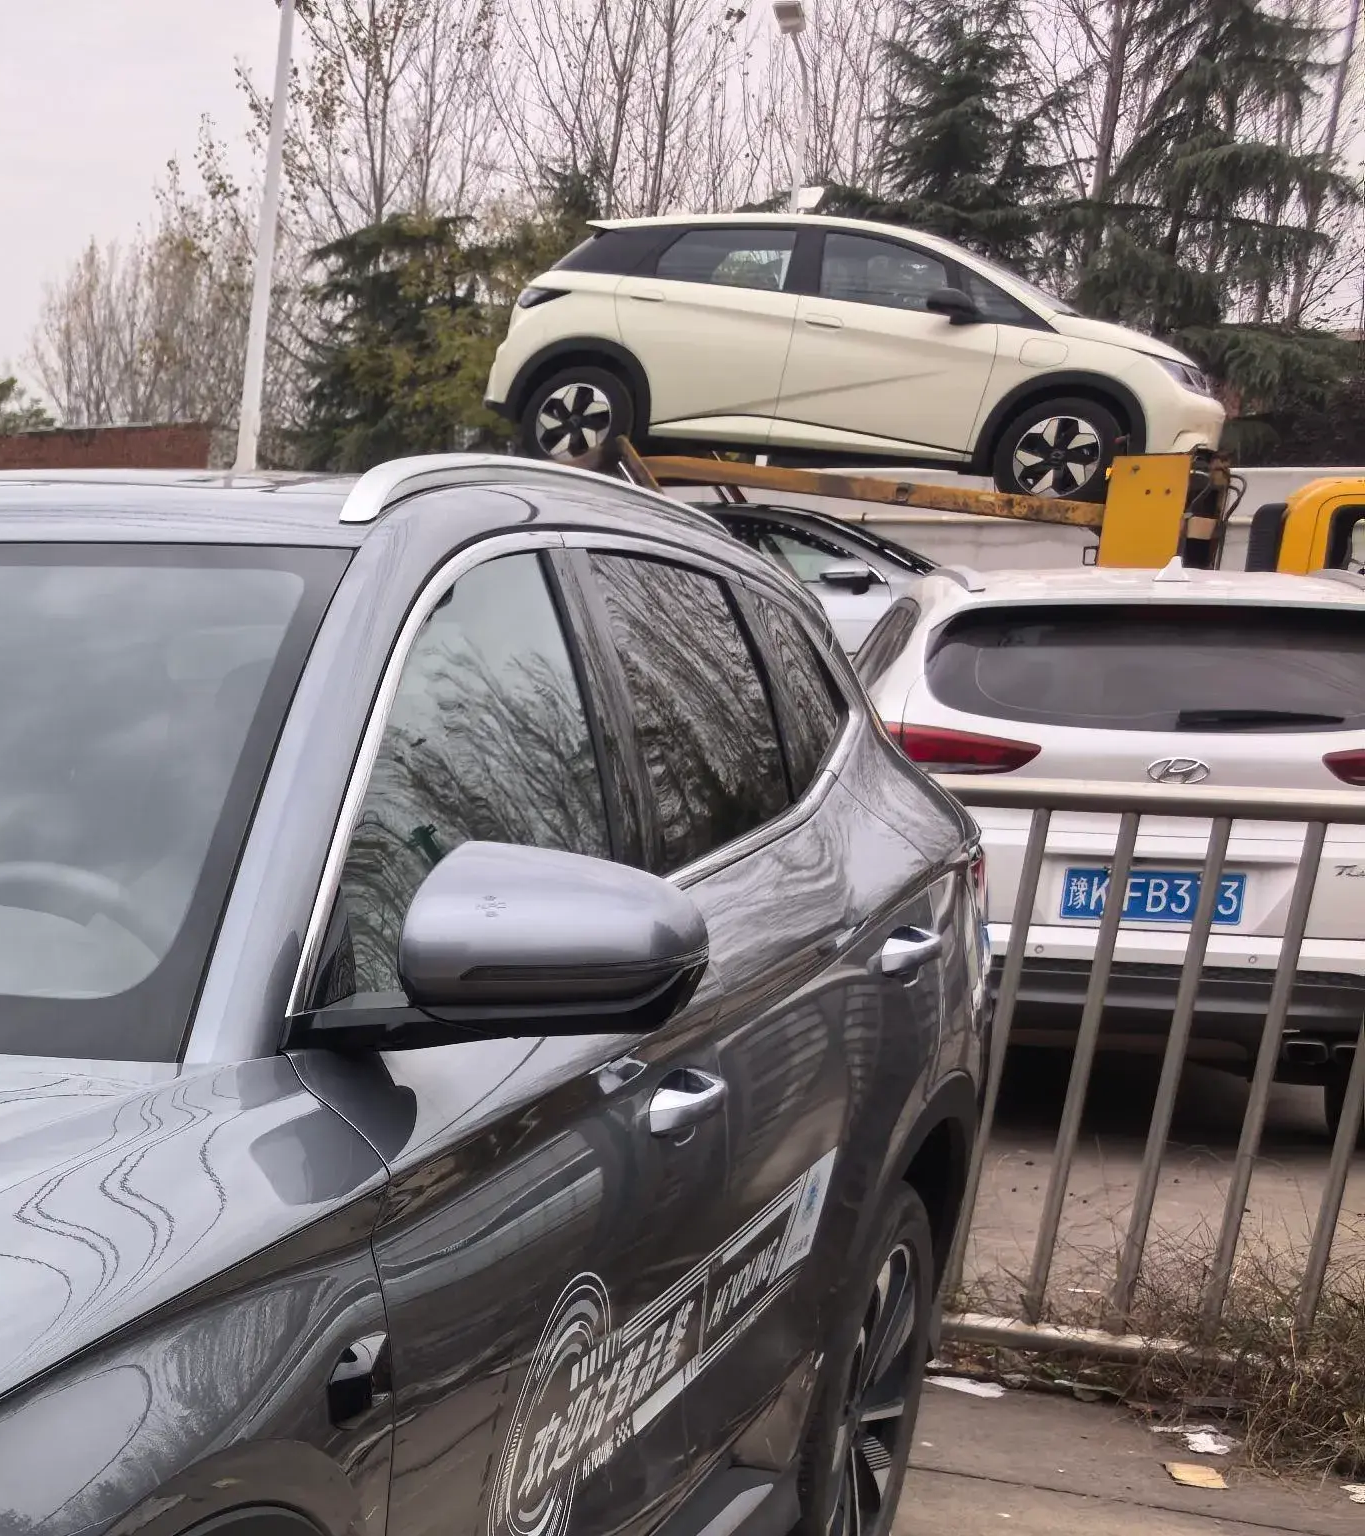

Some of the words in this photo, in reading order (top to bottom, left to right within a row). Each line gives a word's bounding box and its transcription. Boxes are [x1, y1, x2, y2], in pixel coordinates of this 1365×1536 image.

[1068, 876, 1240, 916] 豫KFB33
[518, 1299, 696, 1499] 欢迎试驾品鉴
